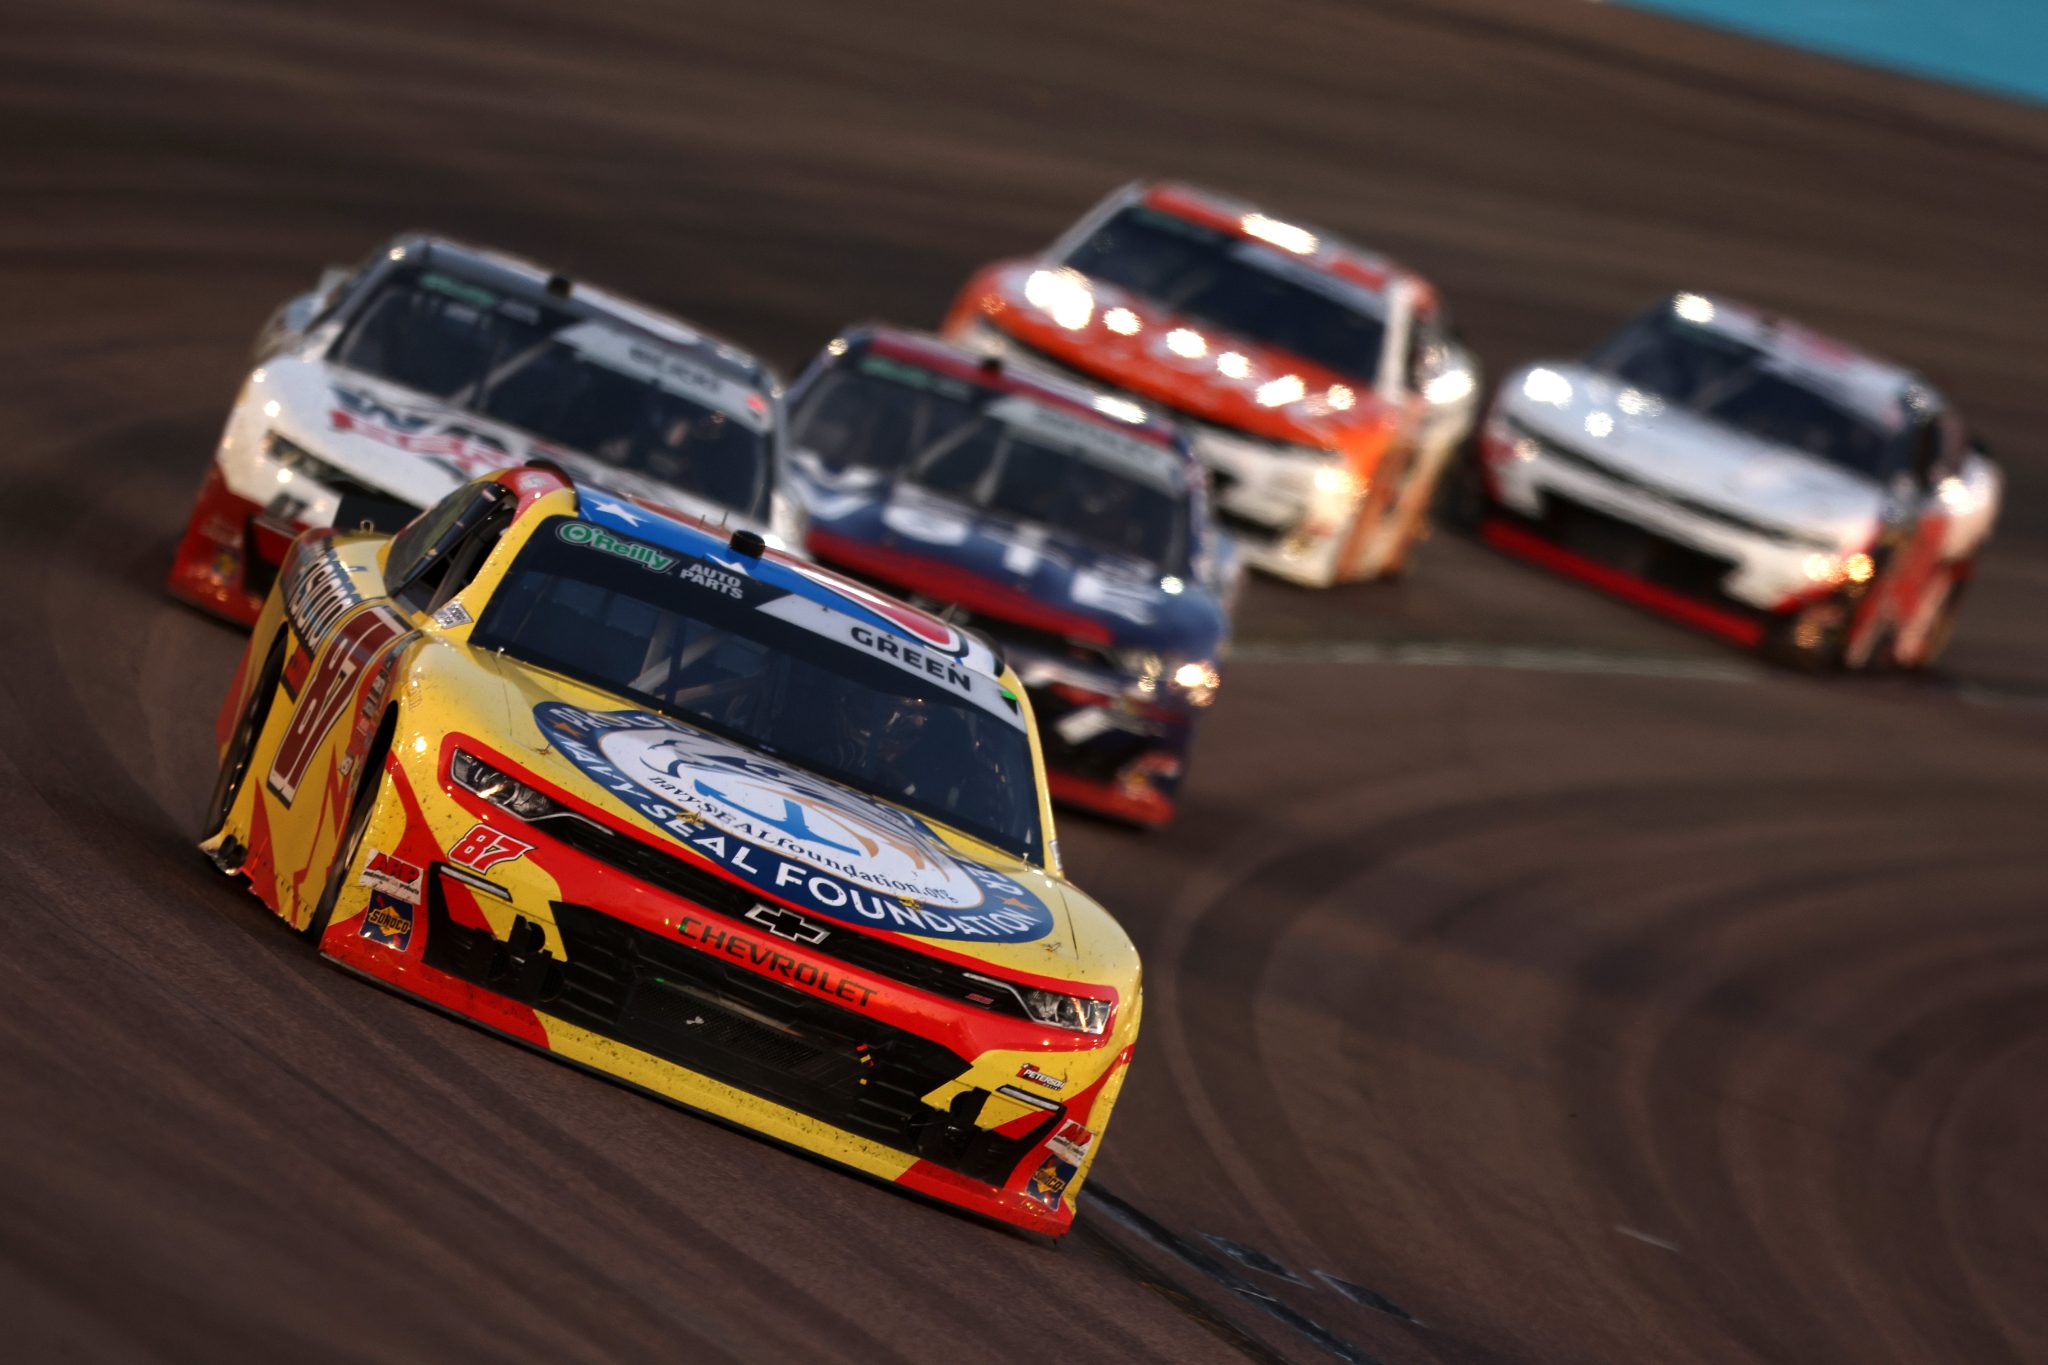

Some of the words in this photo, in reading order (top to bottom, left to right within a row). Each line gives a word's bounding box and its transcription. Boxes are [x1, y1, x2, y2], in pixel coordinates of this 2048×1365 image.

[558, 521, 676, 573] O'Reilly
[679, 569, 743, 600] PARTS
[688, 563, 742, 589] AUTO
[850, 626, 973, 693] GREEN
[447, 823, 538, 875] 87
[553, 733, 652, 800] NAVY
[639, 804, 758, 874] SEAL
[775, 862, 1043, 936] FOUNDATION
[366, 851, 420, 885] ARP
[678, 916, 878, 1007] CHEVROLET
[1023, 1069, 1065, 1087] PETERSON
